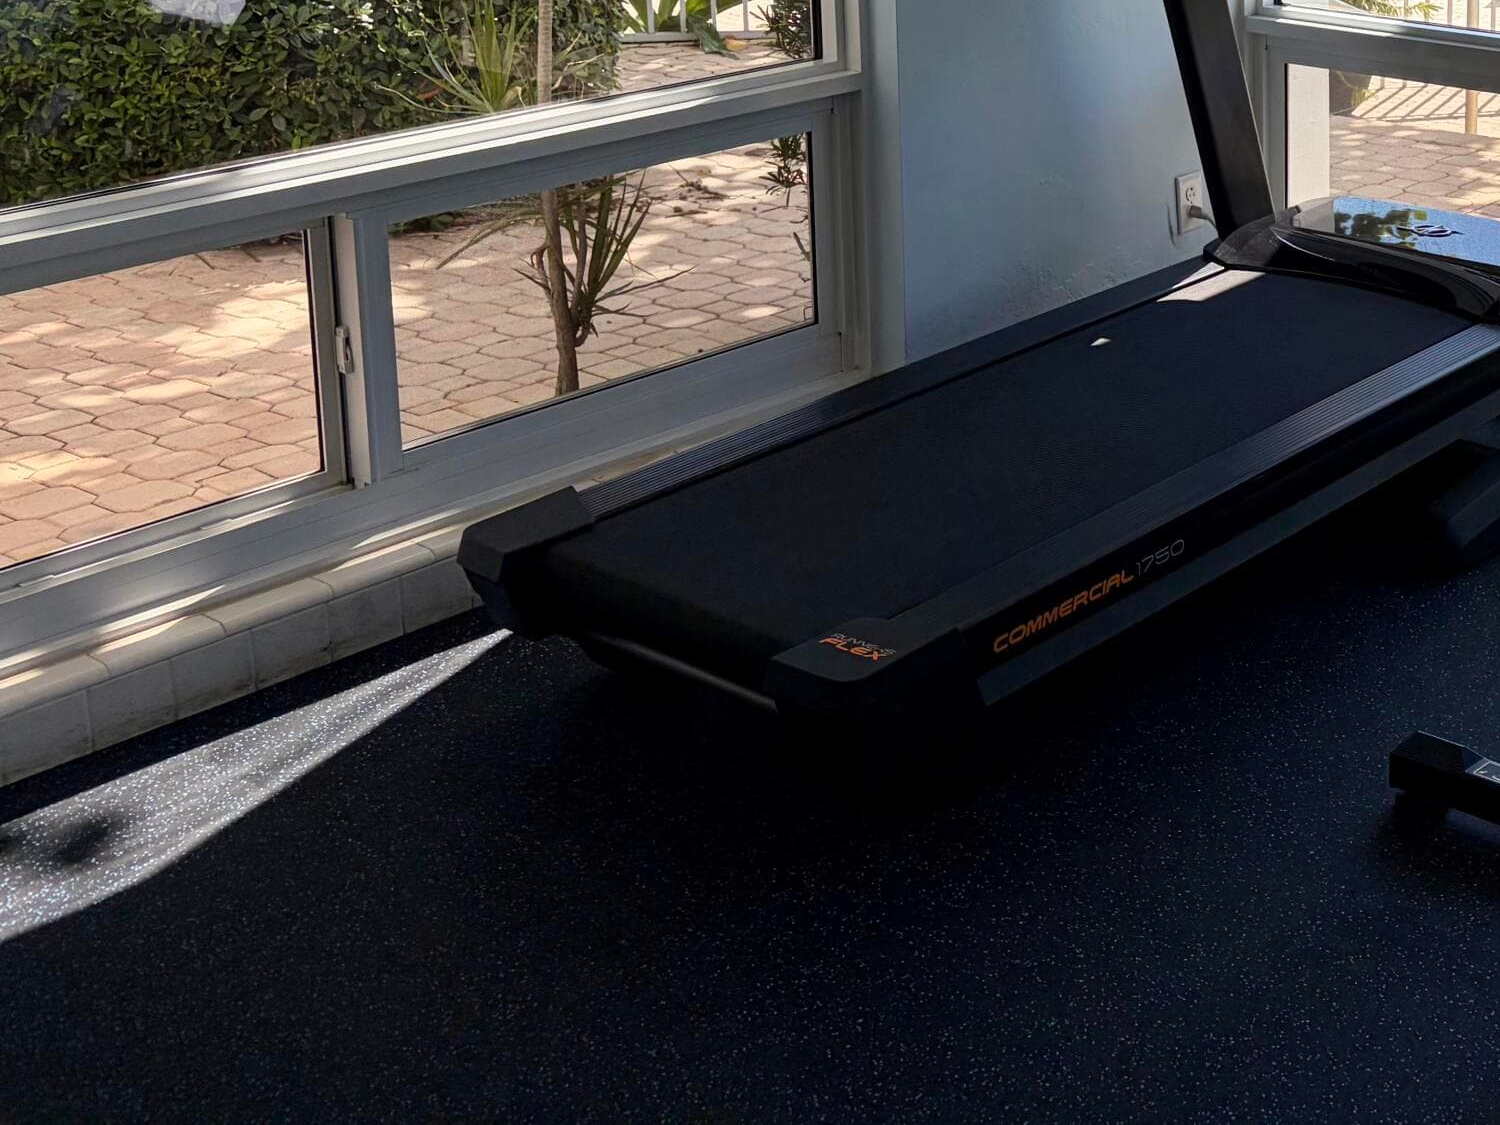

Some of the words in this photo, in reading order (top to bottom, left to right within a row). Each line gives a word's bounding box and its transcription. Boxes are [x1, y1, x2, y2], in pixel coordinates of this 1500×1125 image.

[992, 568, 1135, 654] COMMERCIAL
[1135, 538, 1185, 577] 1750
[818, 636, 888, 661] FLEX
